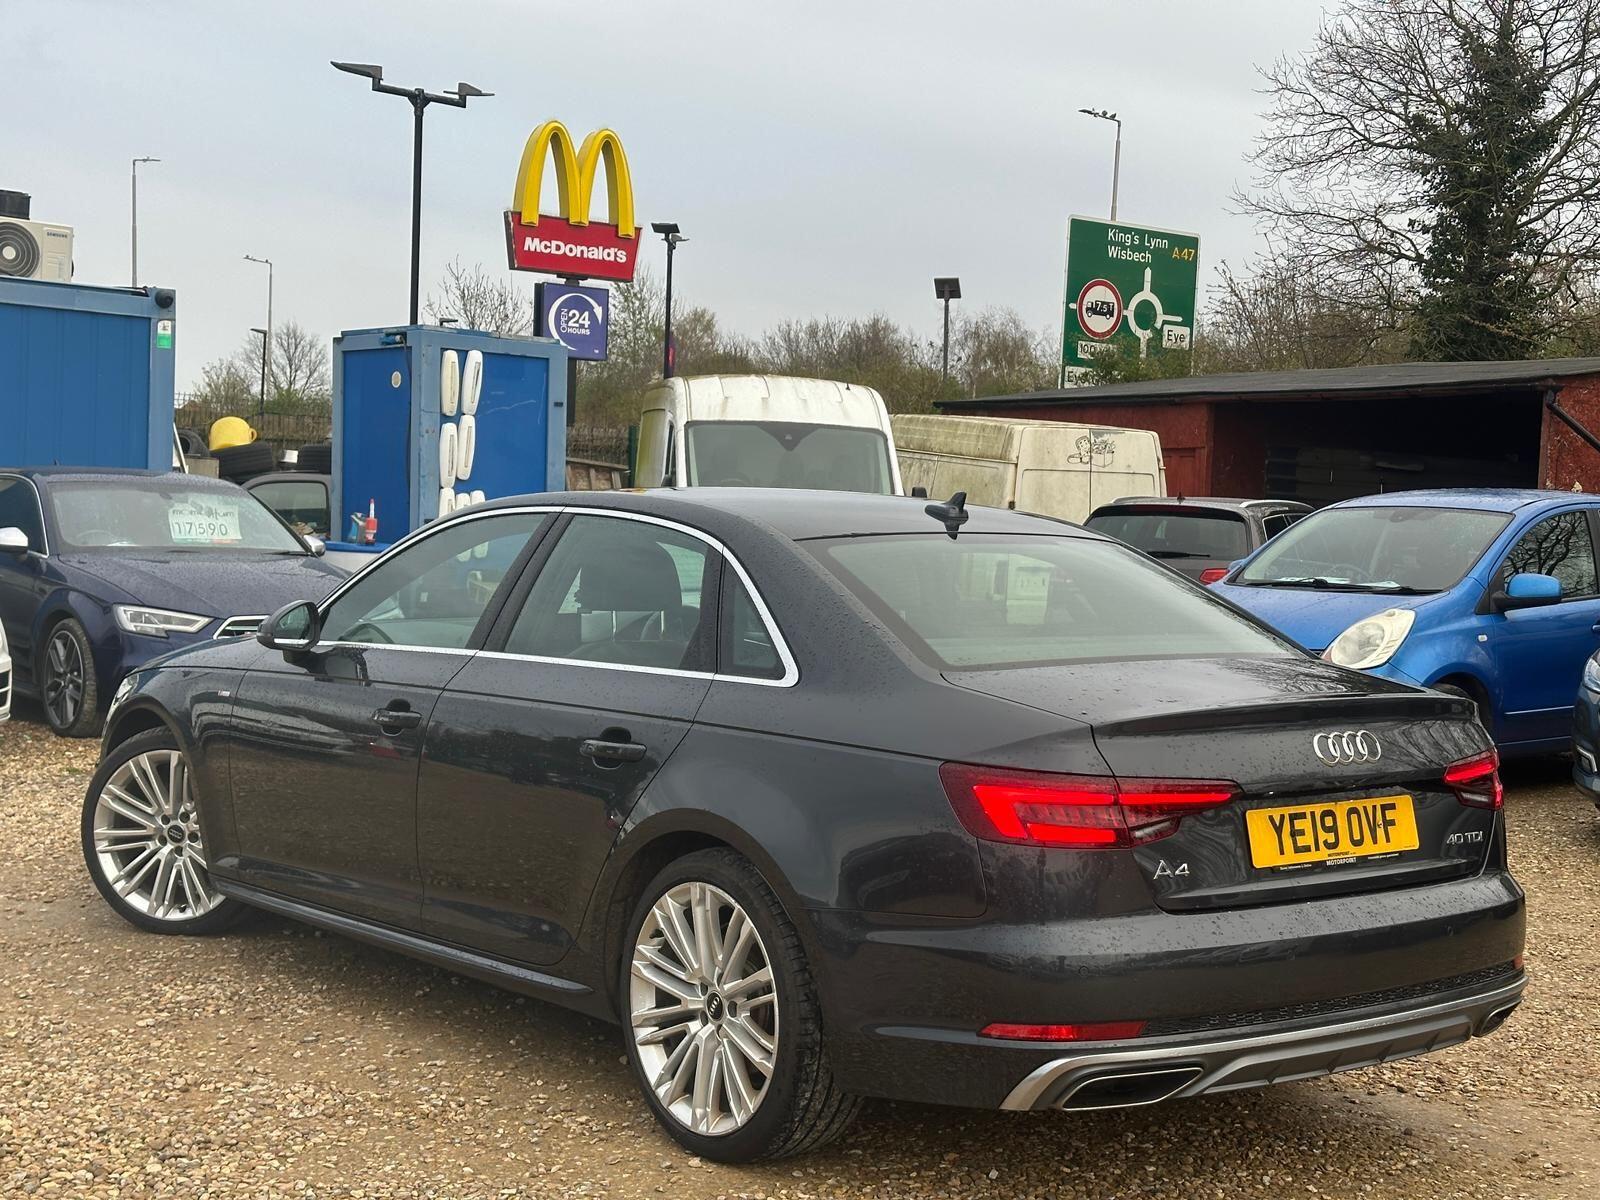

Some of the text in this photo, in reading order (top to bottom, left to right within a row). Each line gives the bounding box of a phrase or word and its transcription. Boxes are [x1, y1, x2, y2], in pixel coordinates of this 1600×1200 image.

[1108, 228, 1169, 250] King's Lynn
[524, 237, 627, 263] McDonald's
[1107, 245, 1152, 263] Wisbech
[1172, 247, 1195, 260] A47
[560, 308, 568, 333] OPEN
[568, 309, 591, 328] 24
[567, 327, 591, 336] HOURS
[1167, 331, 1186, 344] Eye
[174, 521, 229, 537] 17590
[1268, 802, 1397, 856] YE19 OVF
[1446, 830, 1484, 845] 40 TDI
[1152, 859, 1191, 880] A4
[1326, 858, 1357, 866] MOTORPOINT
